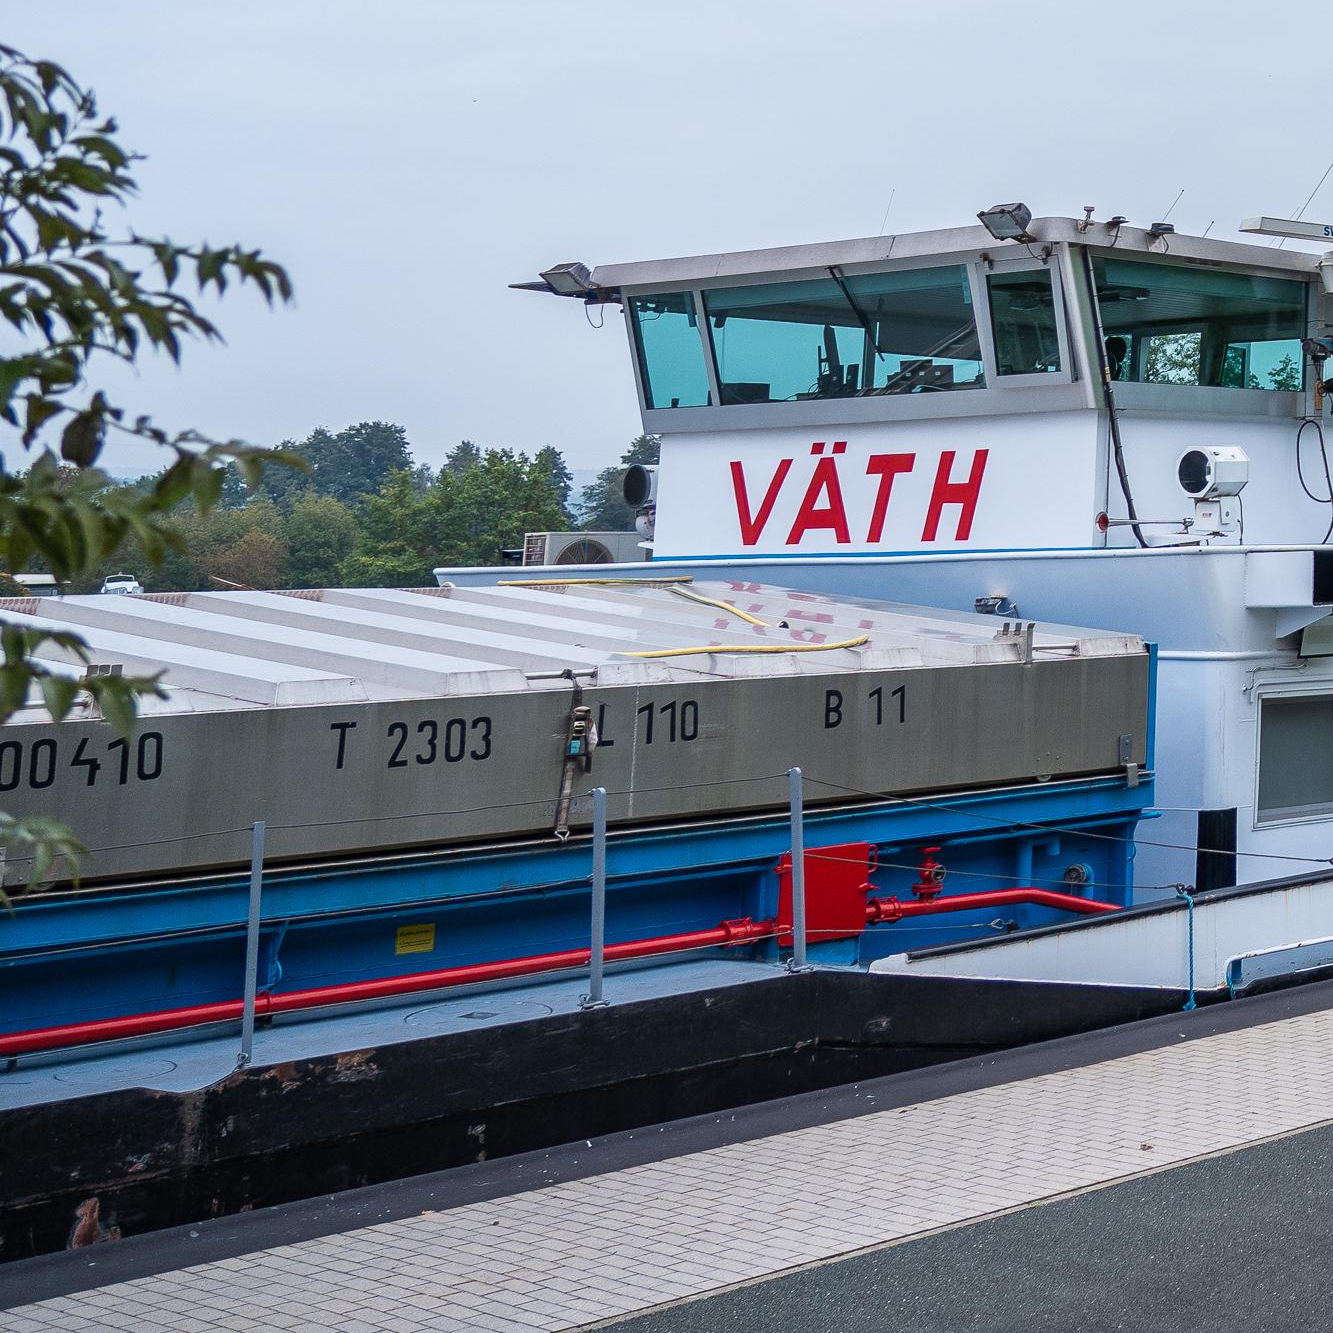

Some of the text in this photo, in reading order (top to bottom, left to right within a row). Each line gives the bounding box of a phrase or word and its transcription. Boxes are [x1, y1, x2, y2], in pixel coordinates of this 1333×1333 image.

[729, 441, 989, 546] VÄTH
[597, 700, 699, 747] L 110
[824, 685, 906, 729] B 11
[330, 717, 492, 769] T 2303
